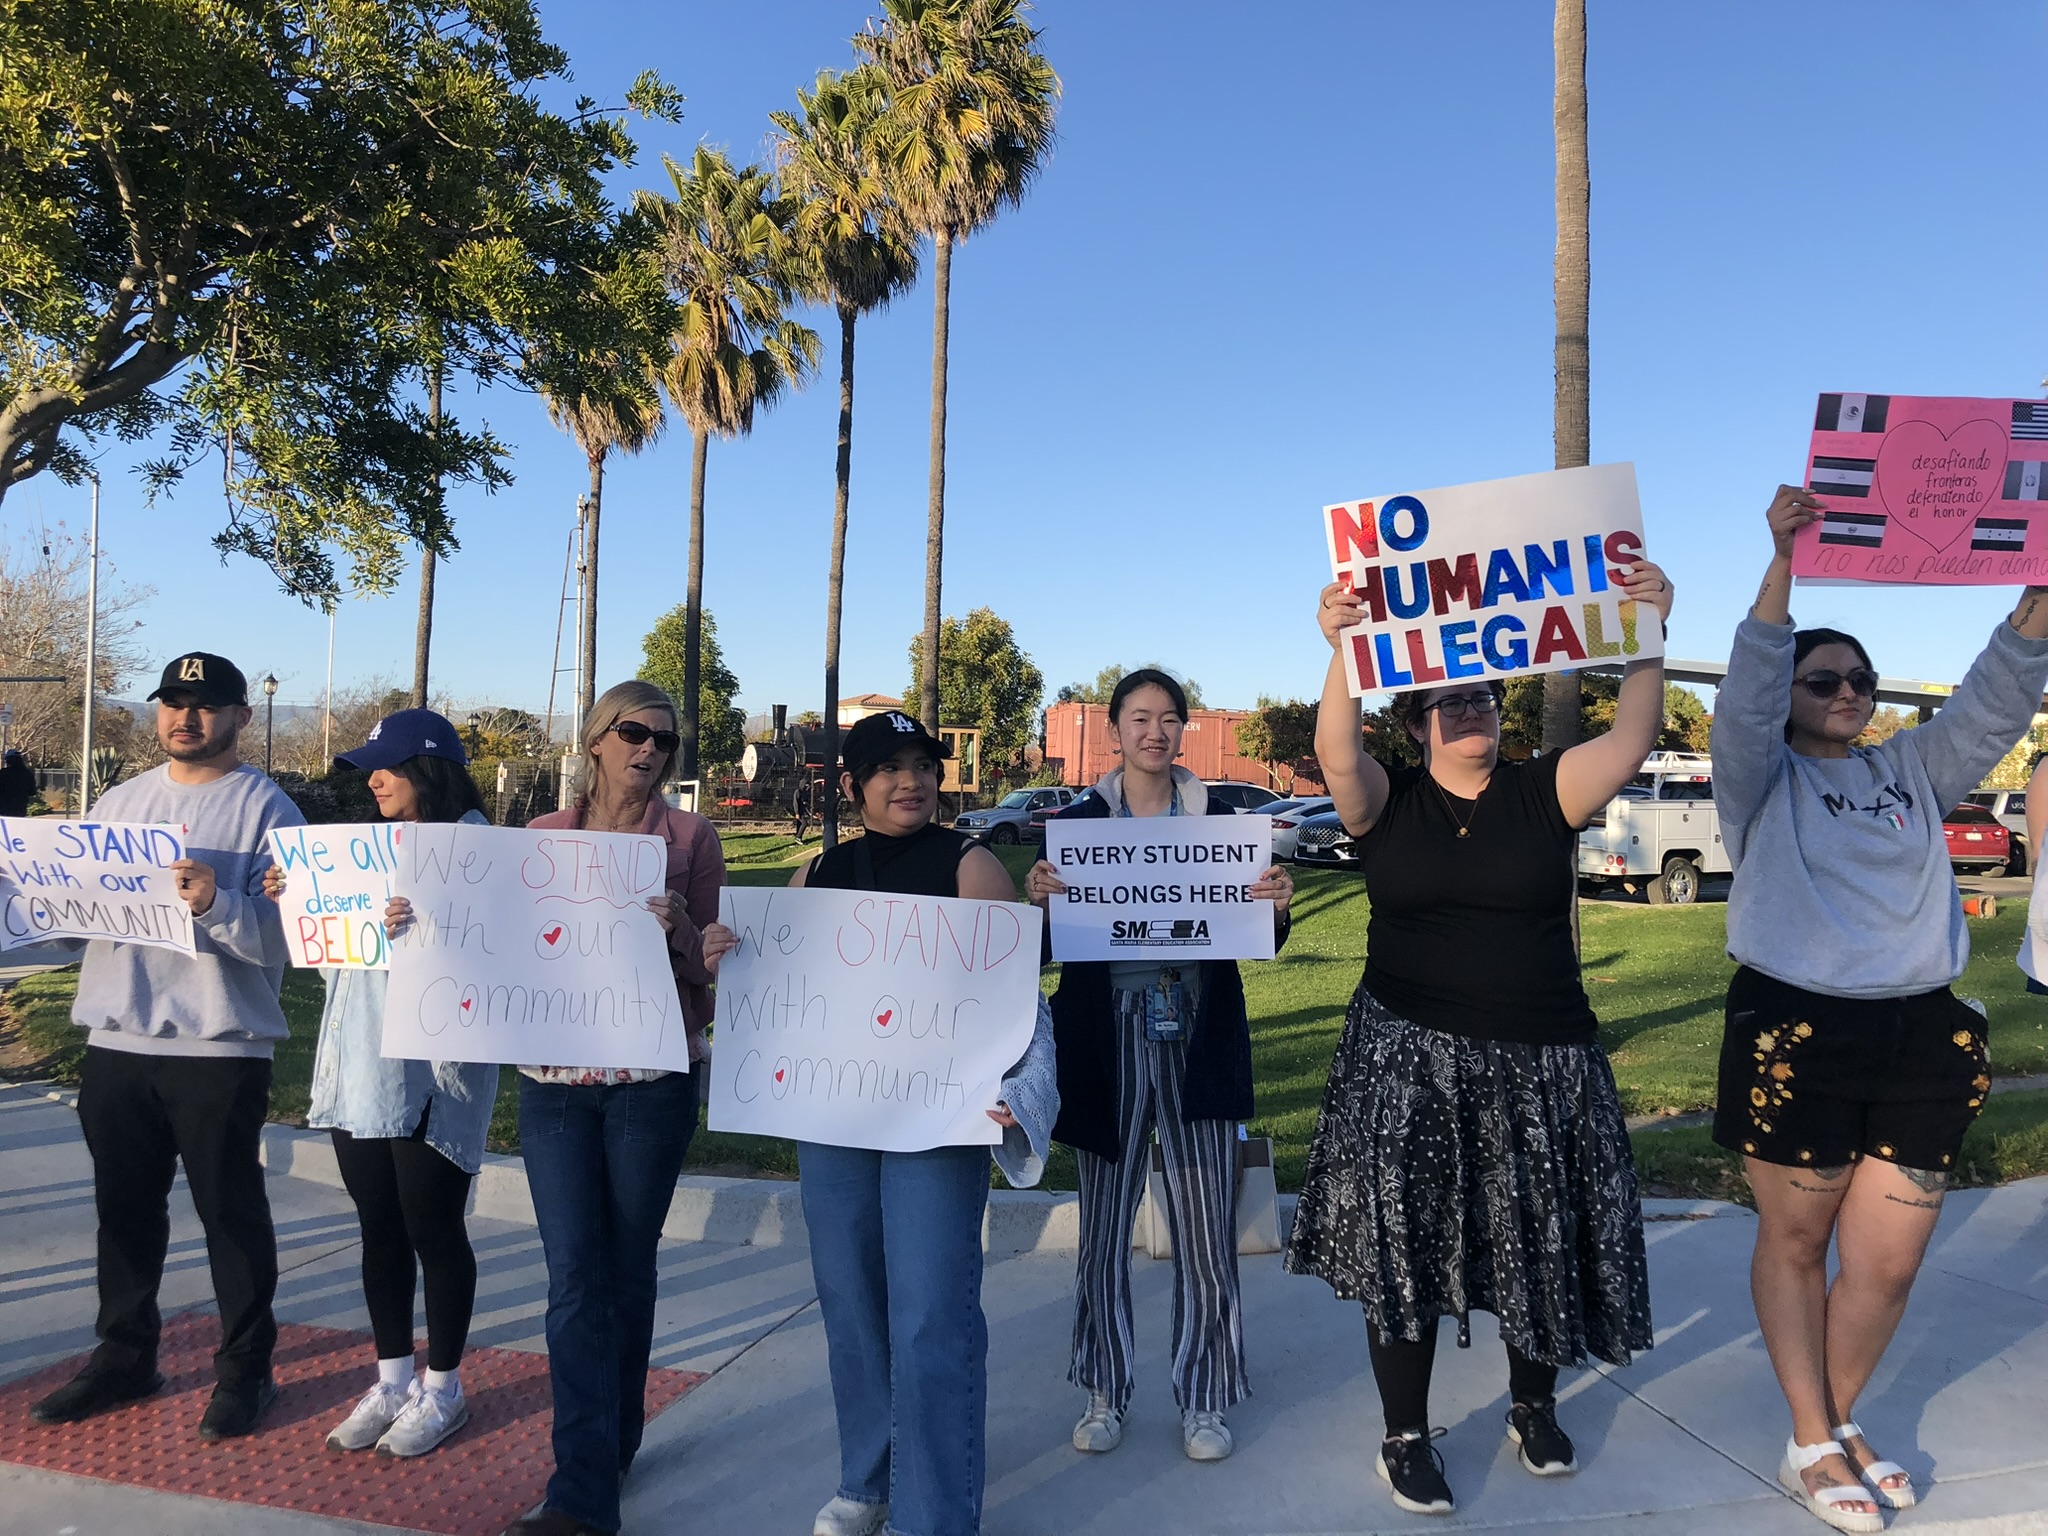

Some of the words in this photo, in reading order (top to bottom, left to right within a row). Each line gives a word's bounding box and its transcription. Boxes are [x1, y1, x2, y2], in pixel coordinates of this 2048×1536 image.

[1911, 448, 1991, 472] desafiando
[1906, 488, 1984, 507] defendiendo
[1908, 507, 1919, 518] el
[1933, 504, 1968, 519] honor
[1330, 495, 1429, 563] NO
[1337, 539, 1575, 623] HUMAN
[1583, 530, 1645, 593] IS
[1814, 547, 1852, 573] no
[1866, 553, 1908, 575] nos
[1914, 549, 1992, 580] pueden
[1350, 599, 1641, 691] ILLEGAL!
[886, 713, 916, 732] LA
[54, 823, 182, 869] STAND
[273, 828, 335, 873] We
[349, 825, 397, 874] all
[414, 826, 492, 885] We
[521, 838, 662, 897] STAND
[1060, 846, 1137, 865] EVERY
[1143, 844, 1258, 864] STUDENT
[100, 873, 151, 893] our
[306, 870, 373, 915] deserve
[1067, 885, 1182, 904] BELONGS
[1190, 884, 1254, 903] HERE
[5, 894, 189, 944] COMMUNITY
[298, 915, 394, 967] BELON
[534, 919, 631, 960] our
[729, 892, 805, 958] We
[836, 898, 1021, 972] STAND
[418, 966, 669, 1056] Community
[870, 994, 981, 1040] our
